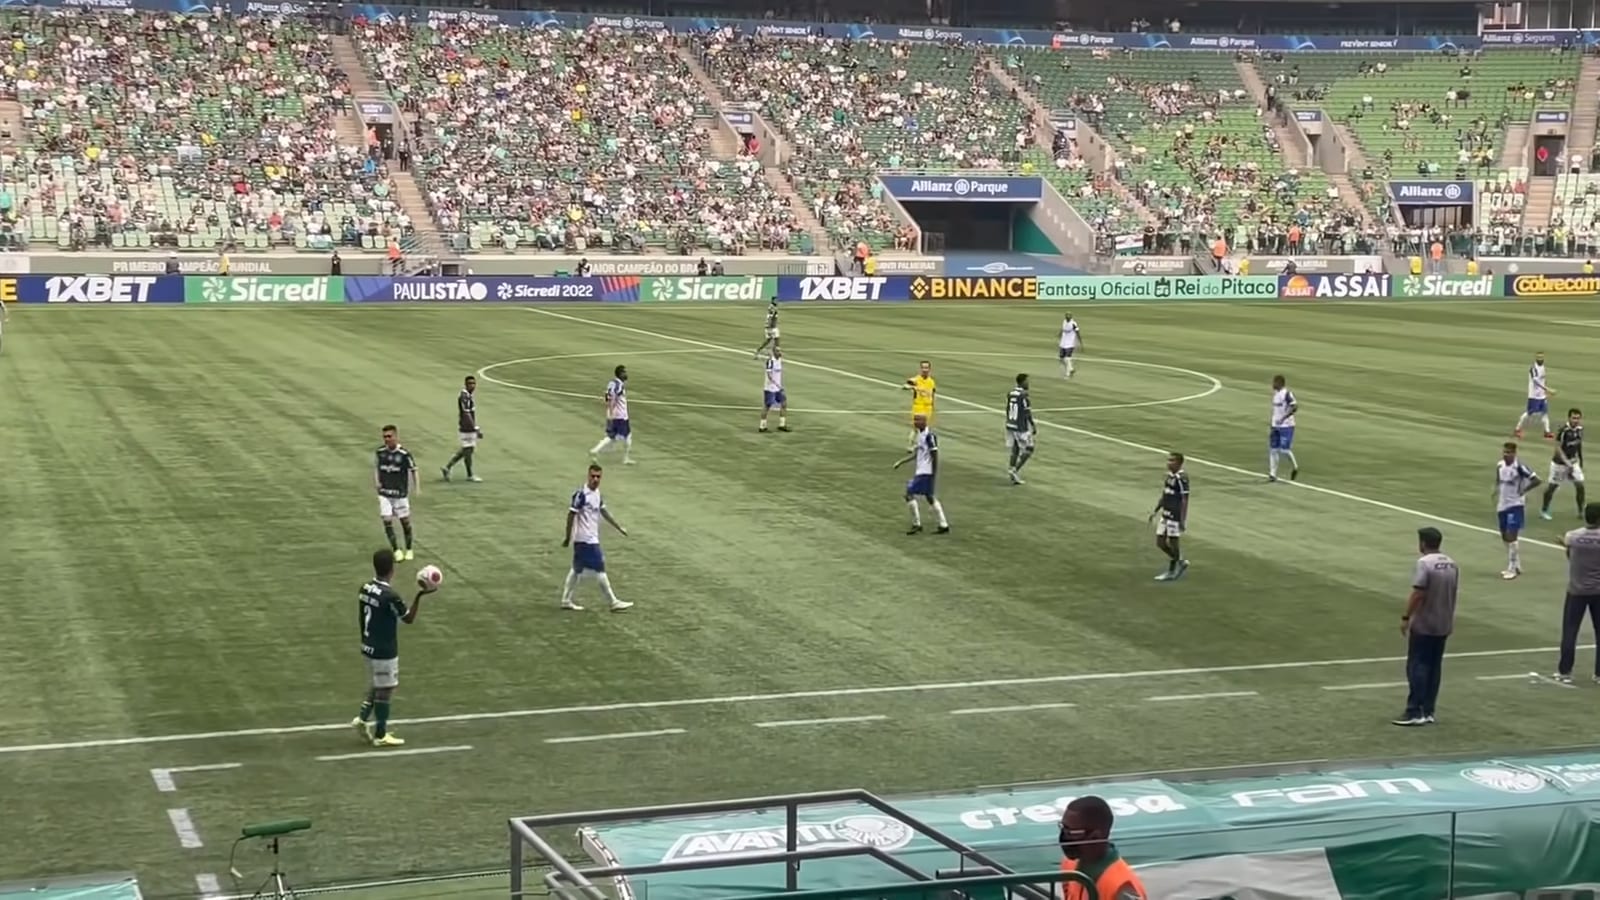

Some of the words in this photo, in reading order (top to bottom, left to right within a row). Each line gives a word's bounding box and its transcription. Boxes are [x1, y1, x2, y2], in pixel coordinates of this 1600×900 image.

[1190, 38, 1218, 46] Allianz
[1482, 34, 1512, 43] Allianz
[1524, 35, 1555, 45] Seguros
[911, 181, 953, 194] Allianz
[970, 182, 1008, 197] Parque
[1399, 185, 1443, 198] Allianz
[45, 276, 157, 303] 1XBET
[231, 277, 328, 302] Sicredi
[514, 284, 560, 297] Sicredi
[562, 285, 593, 300] 2022
[676, 276, 763, 301] Sicredi
[800, 276, 887, 301] 1XBET
[931, 278, 1036, 298] BINANCE
[1037, 282, 1097, 300] Fantasy
[1101, 281, 1150, 296] Oficial
[1175, 278, 1200, 295] Rei
[1202, 284, 1220, 295] do
[1221, 278, 1276, 295] Pitaco
[1423, 274, 1493, 296] Sicredi
